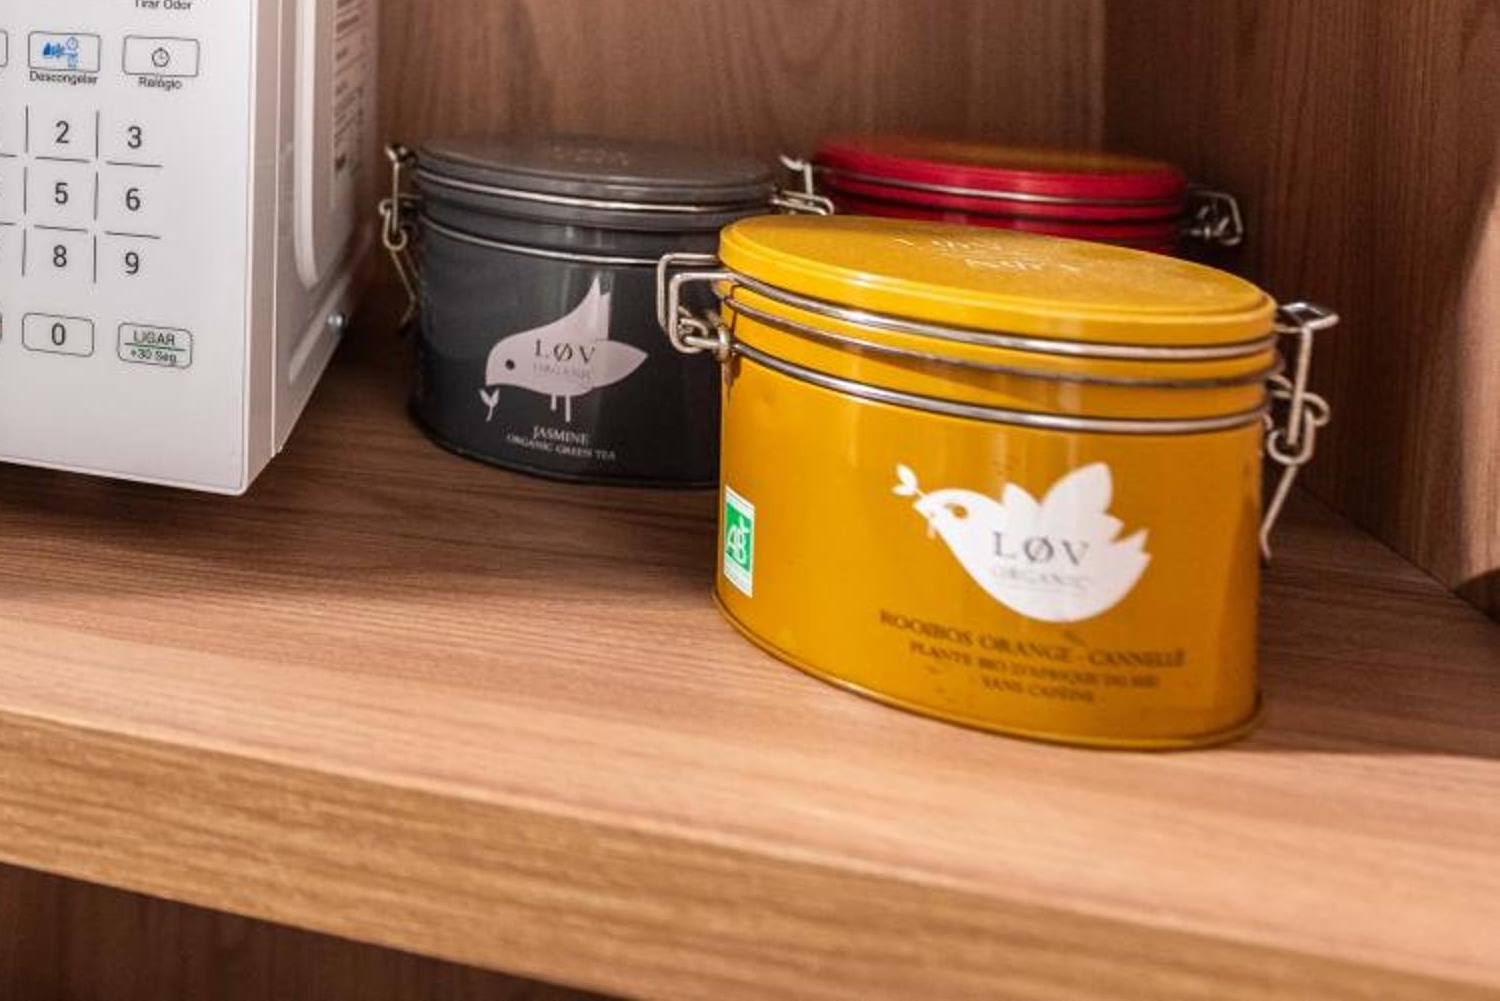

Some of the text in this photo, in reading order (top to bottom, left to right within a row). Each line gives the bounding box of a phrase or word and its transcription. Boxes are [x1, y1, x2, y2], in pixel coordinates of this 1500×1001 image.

[29, 70, 99, 87] Descongelar
[138, 75, 183, 91] Relógio
[55, 121, 71, 145] 2
[126, 126, 143, 150] 3
[53, 181, 69, 206] 5
[124, 188, 141, 212] 6
[52, 245, 68, 269] 8
[124, 252, 140, 276] 9
[51, 323, 66, 347] 0
[133, 329, 176, 346] LIGAR
[534, 339, 596, 365] LØV
[506, 433, 617, 461] ORGANIC GREEN TEA
[533, 425, 589, 446] JASMINE
[992, 530, 1090, 566] LØV
[879, 609, 1186, 667] ROOIBOS ORANGE CANNELLE
[909, 640, 972, 665] PLANTE
